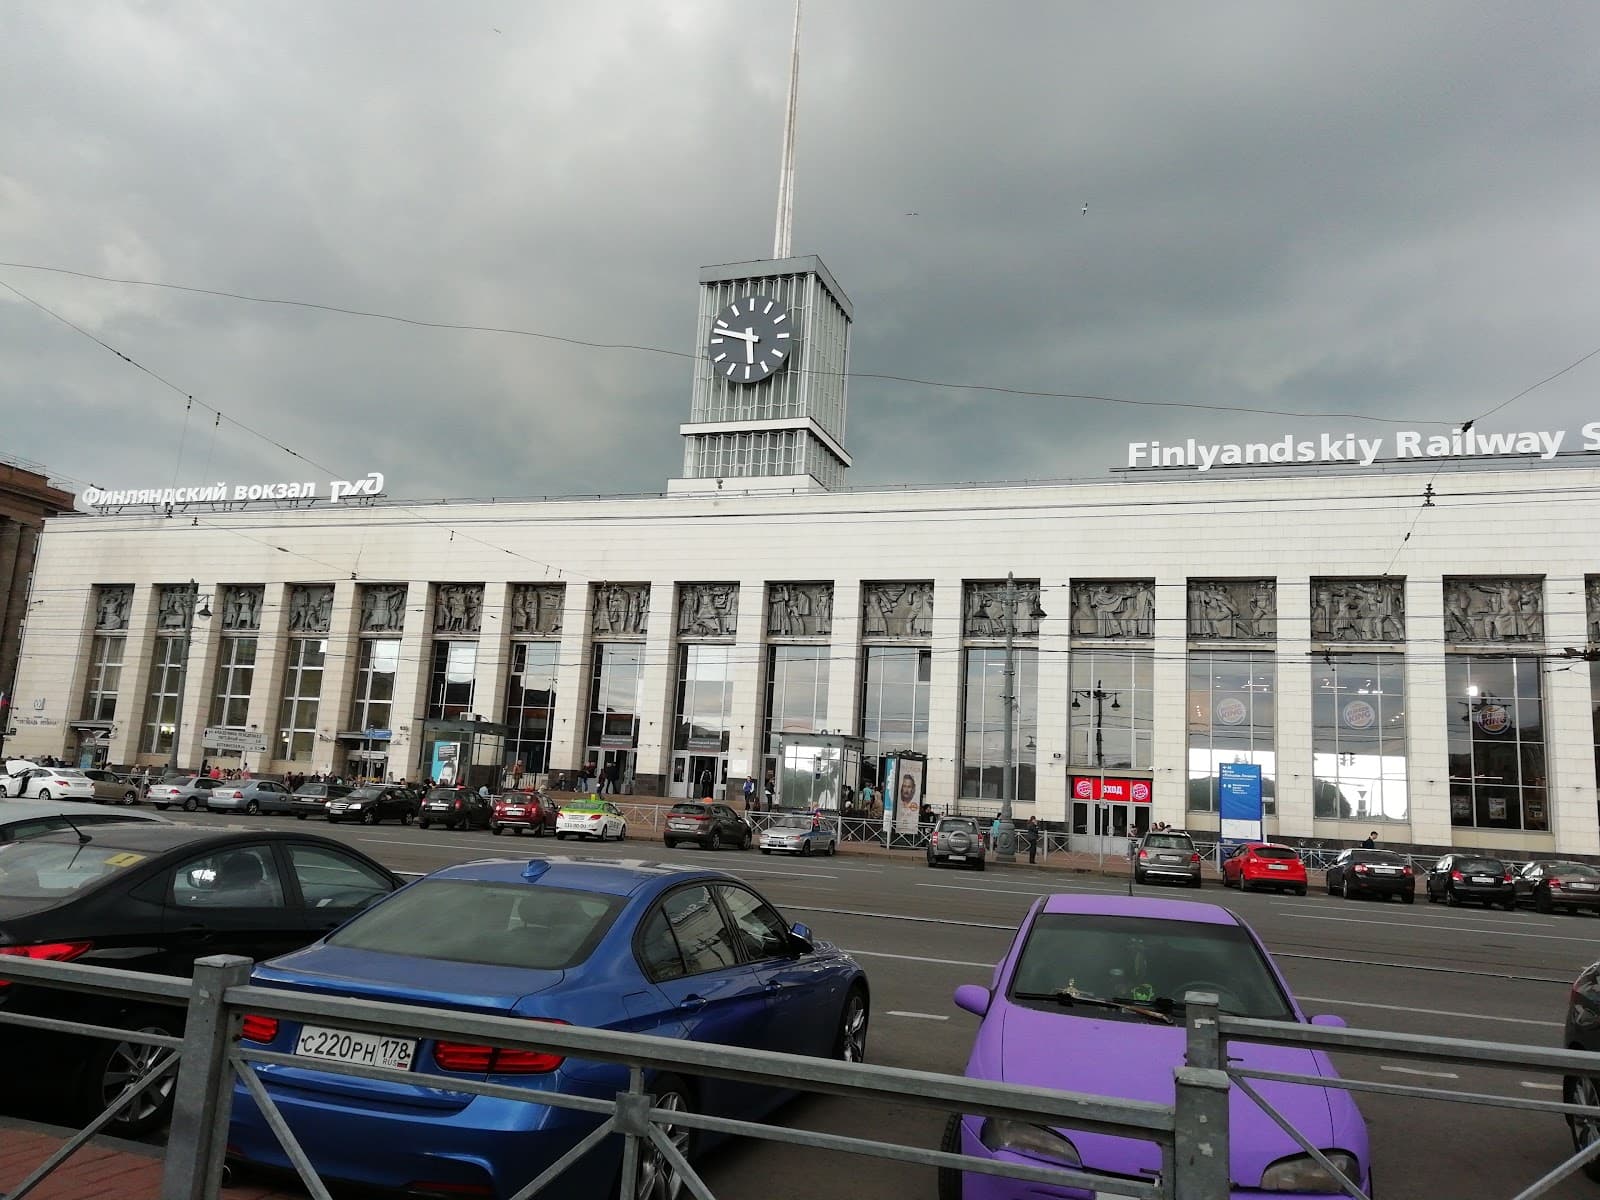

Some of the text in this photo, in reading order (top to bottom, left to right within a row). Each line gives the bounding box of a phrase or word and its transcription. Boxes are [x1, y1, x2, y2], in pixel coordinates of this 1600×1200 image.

[1128, 433, 1383, 471] Finlyandskiy
[1396, 427, 1567, 460] Railway
[82, 481, 316, 507] Финляндский вокзал
[381, 1040, 409, 1060] 178
